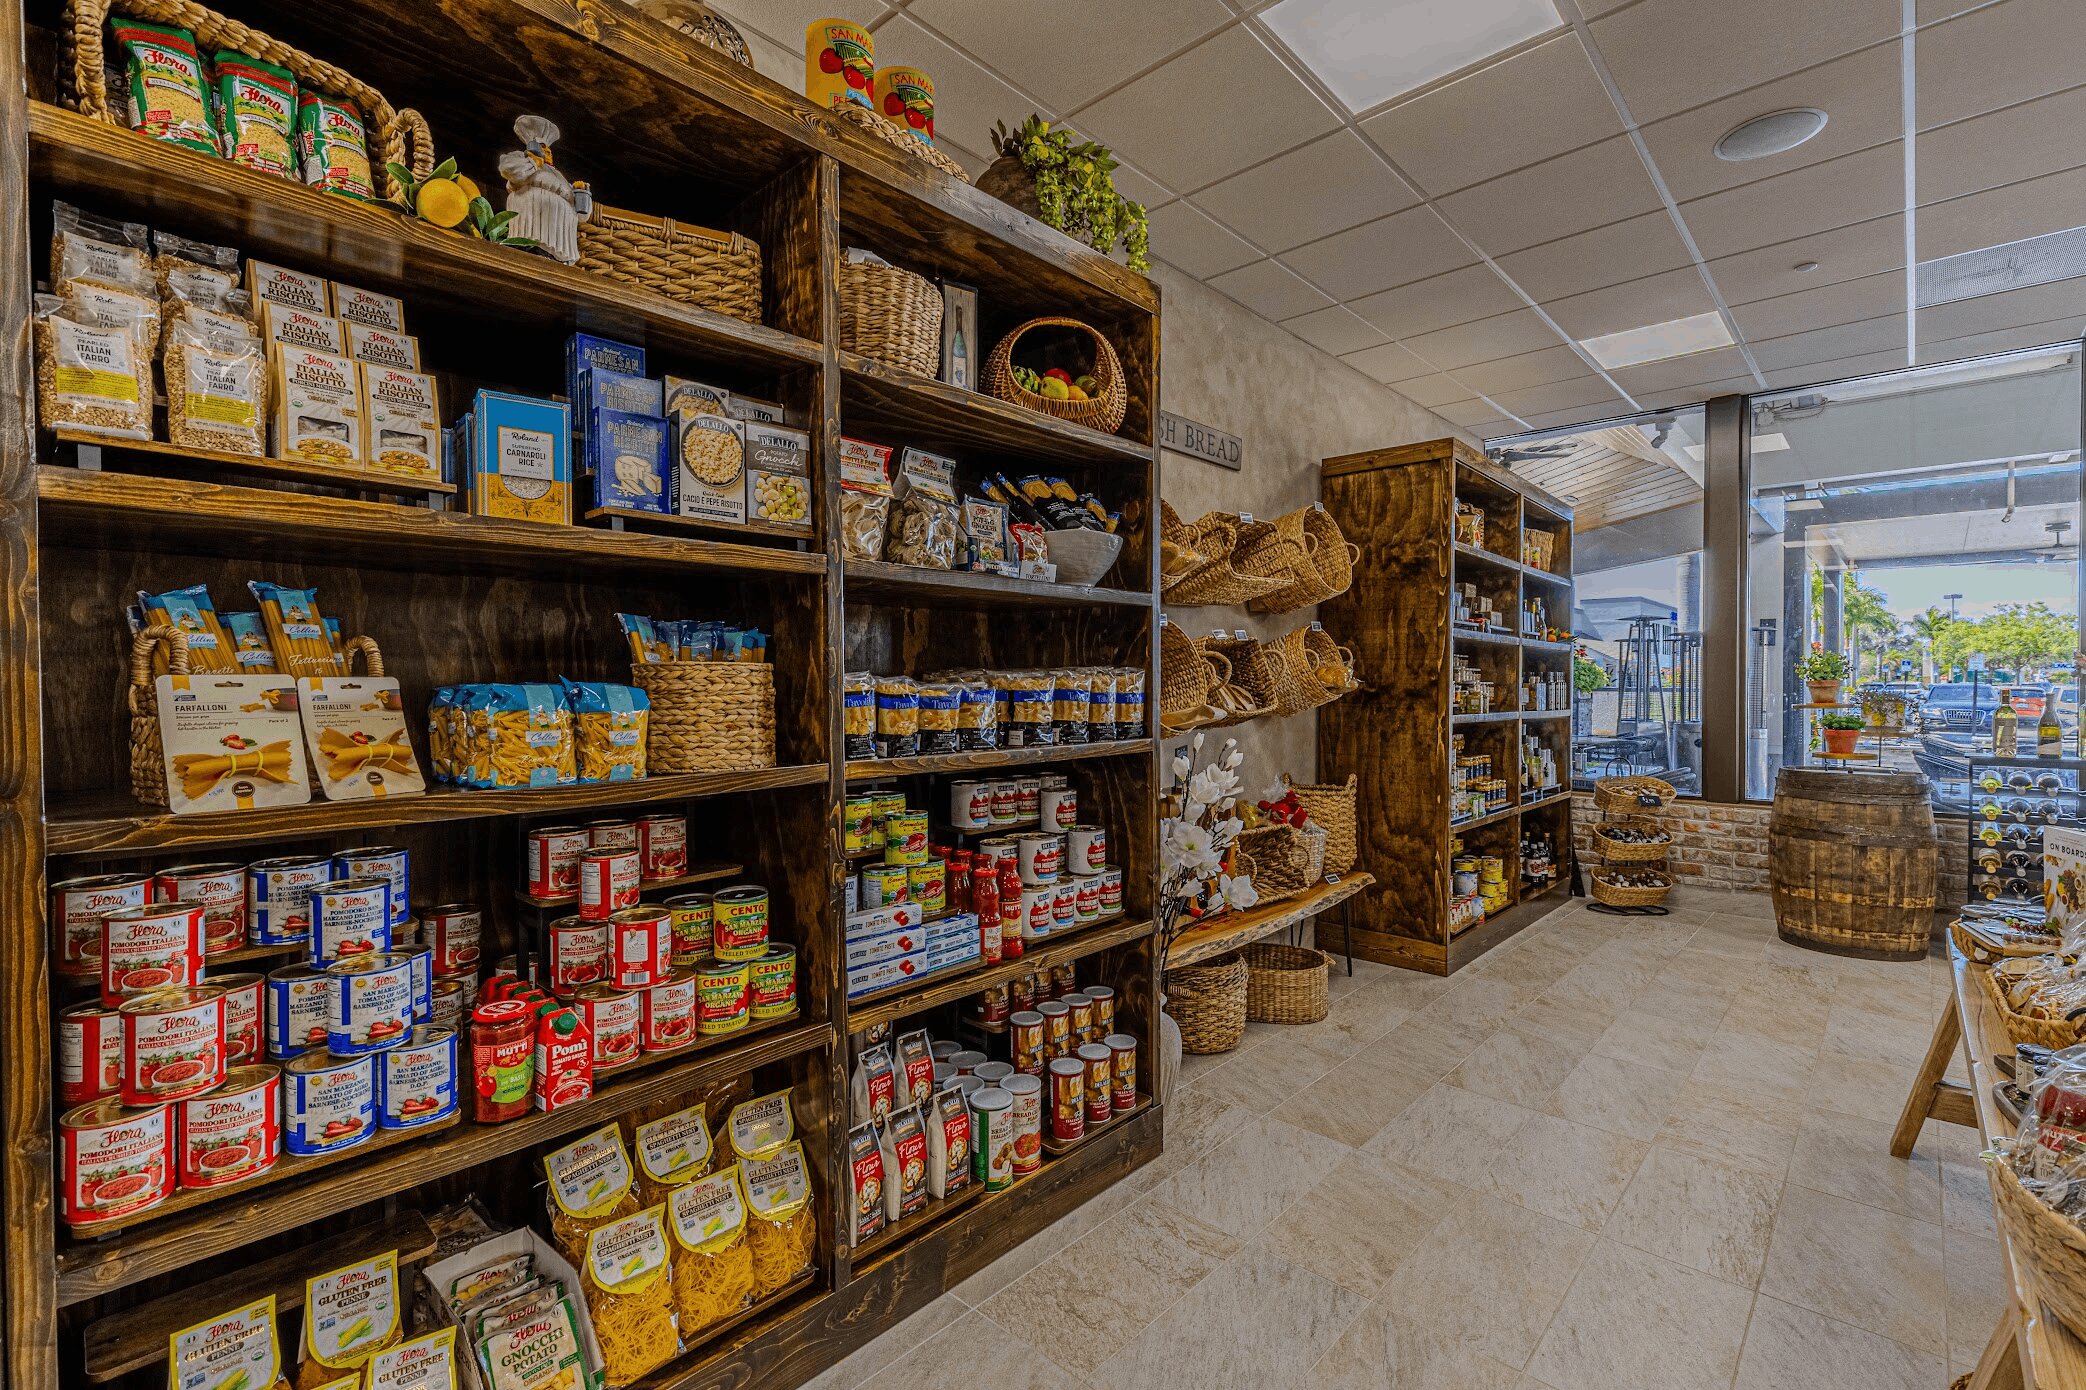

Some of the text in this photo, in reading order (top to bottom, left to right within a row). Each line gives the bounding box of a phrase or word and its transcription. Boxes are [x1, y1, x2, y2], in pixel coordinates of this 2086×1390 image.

[831, 28, 854, 40] SAN
[894, 73, 915, 85] SAN
[89, 266, 118, 279] FARRO
[267, 287, 316, 307] RISOTTO
[268, 280, 314, 299] ITALIAN
[348, 302, 390, 319] ITALIAN
[348, 308, 392, 325] RISOTTO
[72, 325, 109, 338] Roland
[282, 322, 330, 340] ITALIAN
[282, 329, 332, 347] RISOTTO
[76, 343, 112, 357] ITALIAN
[362, 341, 405, 357] ITALIAN
[362, 348, 407, 364] RISOTTO
[79, 352, 111, 365] FARRO
[303, 353, 337, 371] Flora
[584, 347, 639, 372] PARMESAN
[205, 374, 236, 385] ITALIAN
[295, 363, 345, 381] ITALIAN
[295, 371, 347, 389] RISOTTO
[384, 371, 416, 387] Flora
[208, 381, 235, 392] FARRO
[378, 381, 423, 396] ITALIAN
[682, 387, 714, 400] DELALLO
[377, 387, 425, 404] RISOTTO
[735, 406, 772, 422] DELALLO
[607, 420, 663, 443] PARMESAN
[696, 419, 729, 432] DELALLO
[511, 432, 539, 442] Roland
[760, 436, 798, 451] DELALLO
[1185, 424, 1240, 463] BREAD
[506, 448, 546, 460] CARNAROLI
[511, 444, 541, 452] SUPERFINO
[518, 458, 535, 467] RICE
[754, 450, 803, 467] Gnocchi
[682, 494, 743, 510] CACIO E PEPE RISOTTO
[289, 625, 321, 635] Cellino
[175, 704, 227, 712] FARFALLONI
[530, 732, 561, 742] Cellino
[613, 732, 639, 741] Cellino
[2050, 843, 2060, 852] ON
[85, 894, 127, 910] Flora
[341, 896, 370, 909] Flora
[730, 904, 764, 916] CENTO
[330, 908, 366, 916] POMODORO
[126, 924, 168, 940] Flora
[346, 923, 365, 932] D.O.P.
[724, 924, 738, 932] SAN
[732, 926, 763, 936] ORGANIC
[110, 934, 185, 948] POMODORI ITALIANI
[756, 962, 791, 974] CENTO
[871, 970, 886, 979] TOMATO
[886, 967, 897, 976] PASTE
[371, 975, 400, 989] Flora
[703, 976, 739, 988] CENTO
[751, 982, 763, 990] SAN
[759, 983, 789, 994] ORGANIC
[362, 989, 376, 998] SAN
[289, 1000, 319, 1010] MARZANO
[377, 1003, 396, 1012] D.O.P.
[704, 999, 738, 1009] ORGANIC
[157, 1015, 200, 1034] Flora
[138, 1022, 216, 1044] POMODORI ITALIANI
[496, 1041, 528, 1058] MUTTI
[570, 1051, 588, 1062] SAUCE
[396, 1060, 442, 1074] SAN MARZANO
[404, 1052, 433, 1067] Flora
[391, 1064, 445, 1080] TOMATO OF AGRO
[907, 1061, 931, 1077] Flour
[317, 1078, 365, 1096] SAN MARZANO
[327, 1071, 358, 1087] Flora
[409, 1080, 429, 1089] D.O.P.
[870, 1079, 893, 1095] Flour
[312, 1082, 369, 1103] TOMATO OF AGRO
[204, 1102, 245, 1120] Flora
[333, 1101, 354, 1111] D.O.P.
[736, 1098, 782, 1119] GLUTEN FREE
[188, 1107, 263, 1128] POMODORI ITALIANI
[1012, 1111, 1031, 1119] BREAD
[945, 1121, 968, 1137] Flour
[100, 1127, 146, 1149] Flora
[649, 1126, 697, 1149] SPAGHETTI NEST
[79, 1133, 164, 1160] POMODORI ITALIANI
[665, 1143, 687, 1154] ORGANIC
[898, 1142, 924, 1158] Flour
[563, 1153, 615, 1185] SPAGHETTI NEST
[748, 1157, 799, 1178] GLUTEN FREE
[752, 1166, 797, 1184] SPAGHETTI NEST
[855, 1160, 880, 1178] Flour
[581, 1170, 606, 1186] ORGANIC
[677, 1184, 732, 1212] GLUTEN FREE
[596, 1221, 655, 1250] GLUTEN FREE
[617, 1248, 642, 1261] ORGANIC
[336, 1270, 370, 1290] Flora
[318, 1275, 388, 1307] GLUTEN FREE
[340, 1292, 368, 1307] PENNE
[205, 1320, 244, 1343] Flora
[510, 1321, 552, 1349] Flora
[184, 1324, 265, 1362] GLUTEN FREE
[210, 1342, 240, 1360] PENNE
[500, 1326, 566, 1367] GNOCCHI
[396, 1347, 429, 1366] Flora
[513, 1344, 558, 1374] POTATO
[378, 1352, 444, 1384] GLUTEN FREE
[400, 1370, 425, 1385] PENNE
